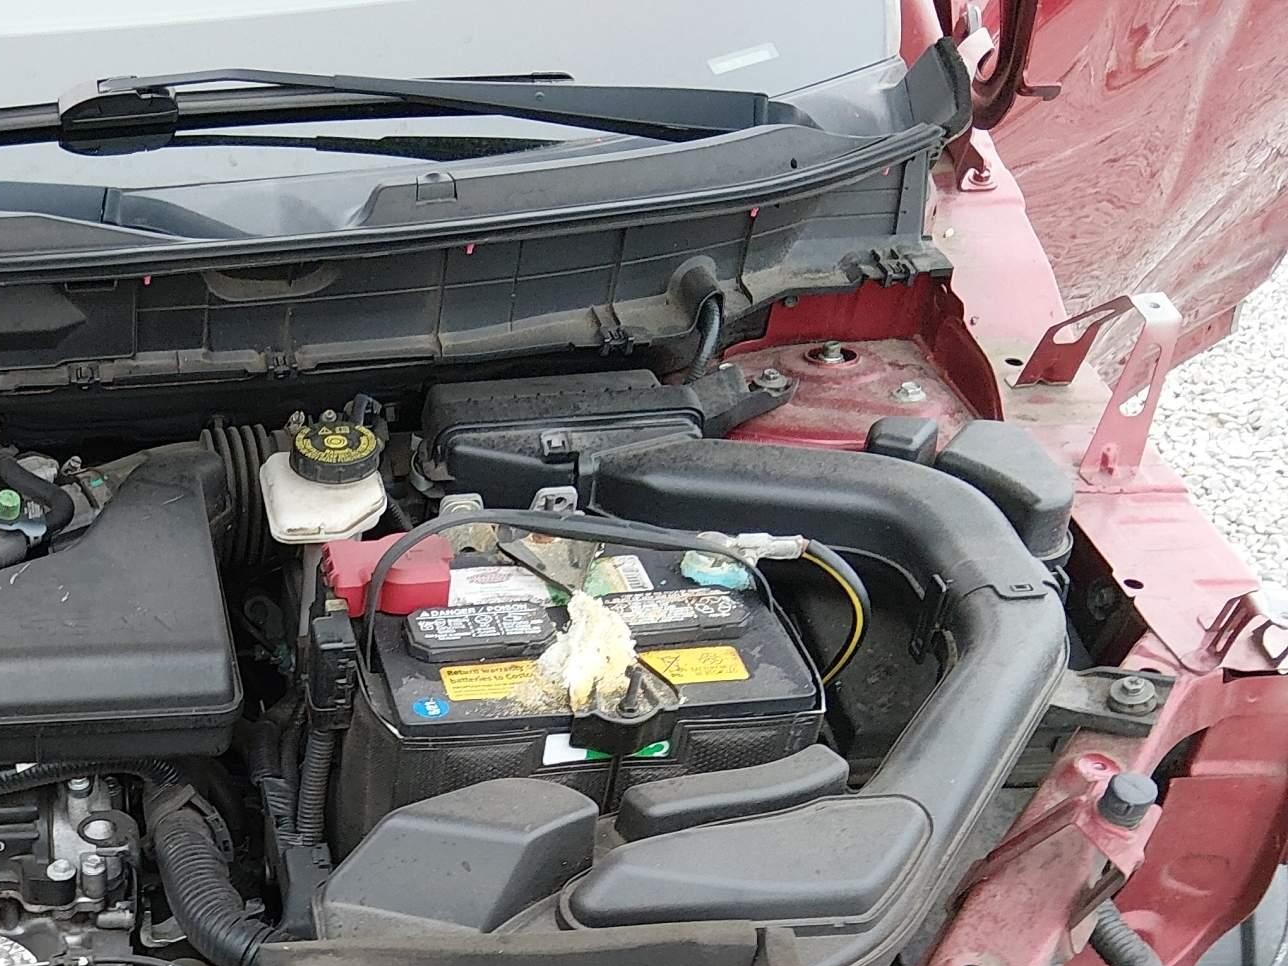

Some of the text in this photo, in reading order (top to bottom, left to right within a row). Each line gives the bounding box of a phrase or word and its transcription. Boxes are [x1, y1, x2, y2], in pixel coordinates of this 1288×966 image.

[430, 607, 476, 617] DANGER
[487, 603, 528, 613] POISON
[446, 667, 480, 677] Return
